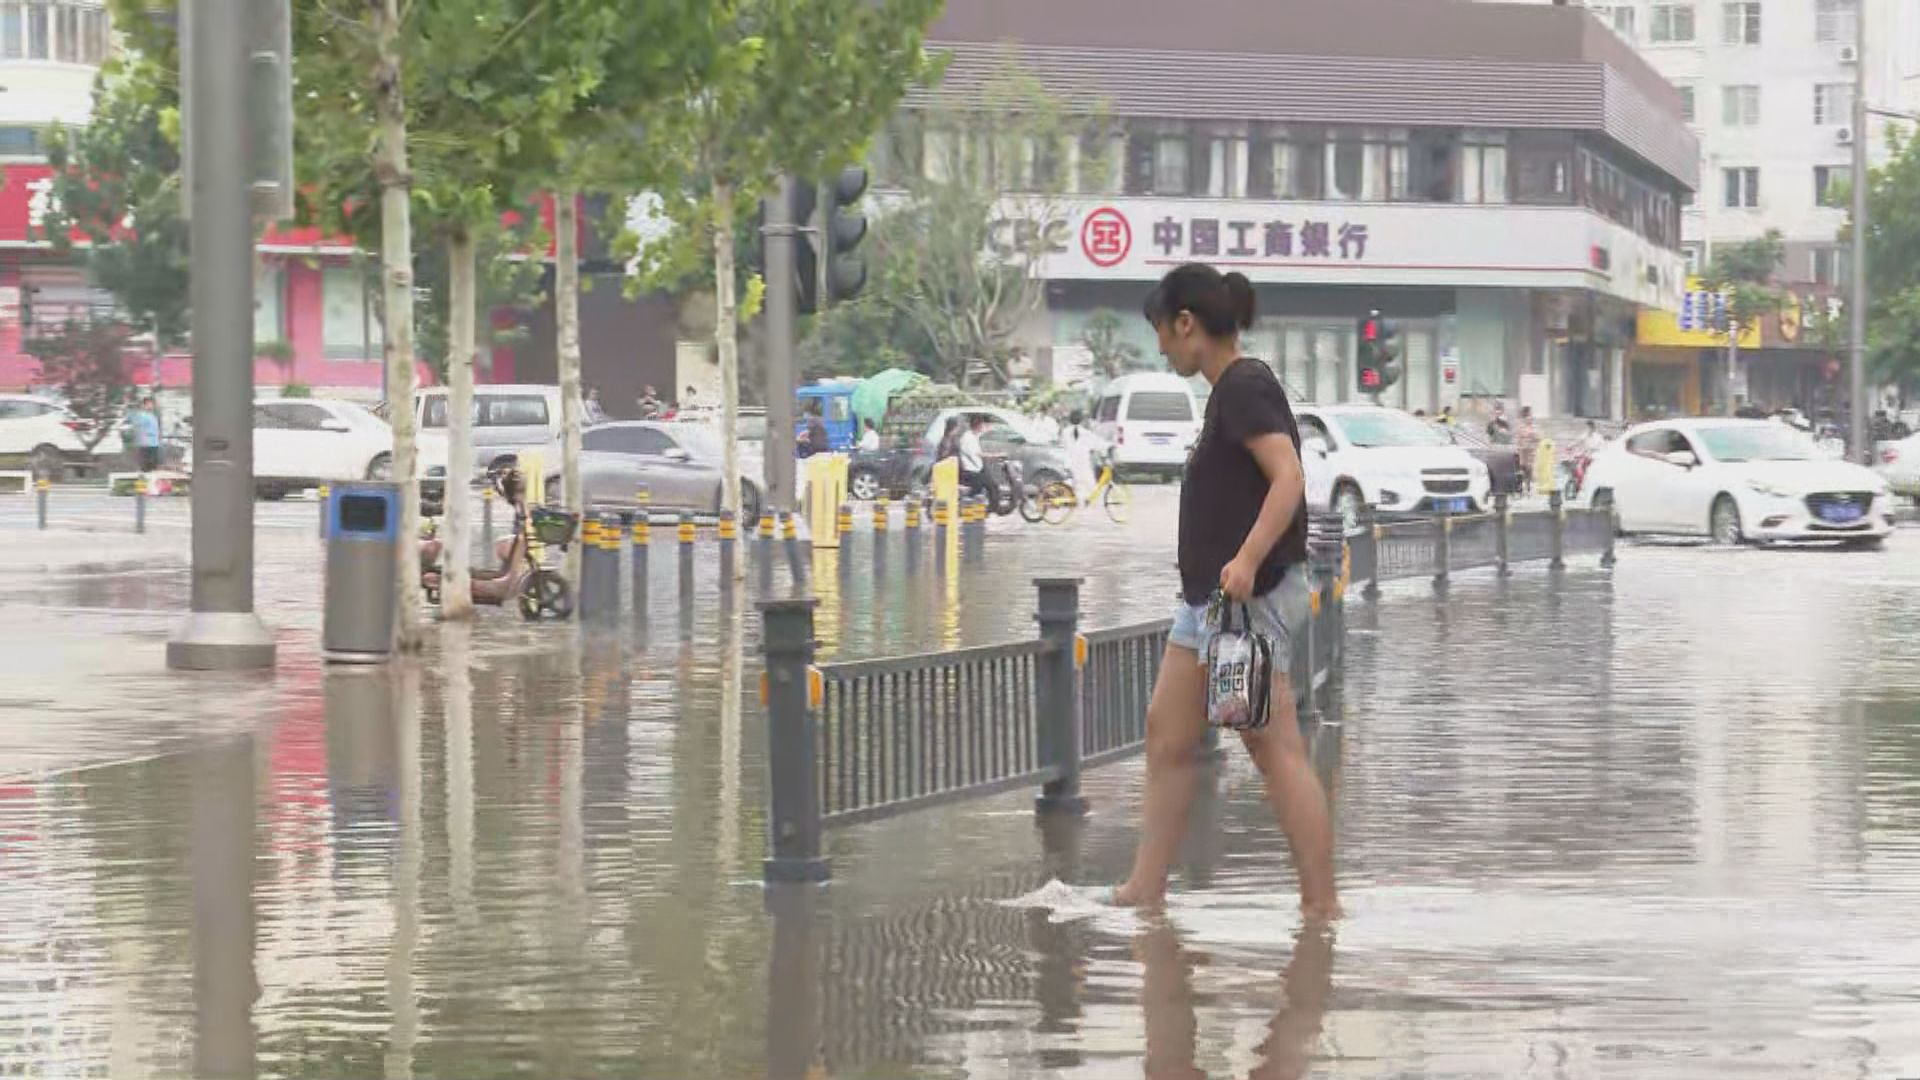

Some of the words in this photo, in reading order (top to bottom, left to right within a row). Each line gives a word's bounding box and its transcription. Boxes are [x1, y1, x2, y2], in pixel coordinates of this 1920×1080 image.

[1152, 216, 1368, 259] 中国工商银行
